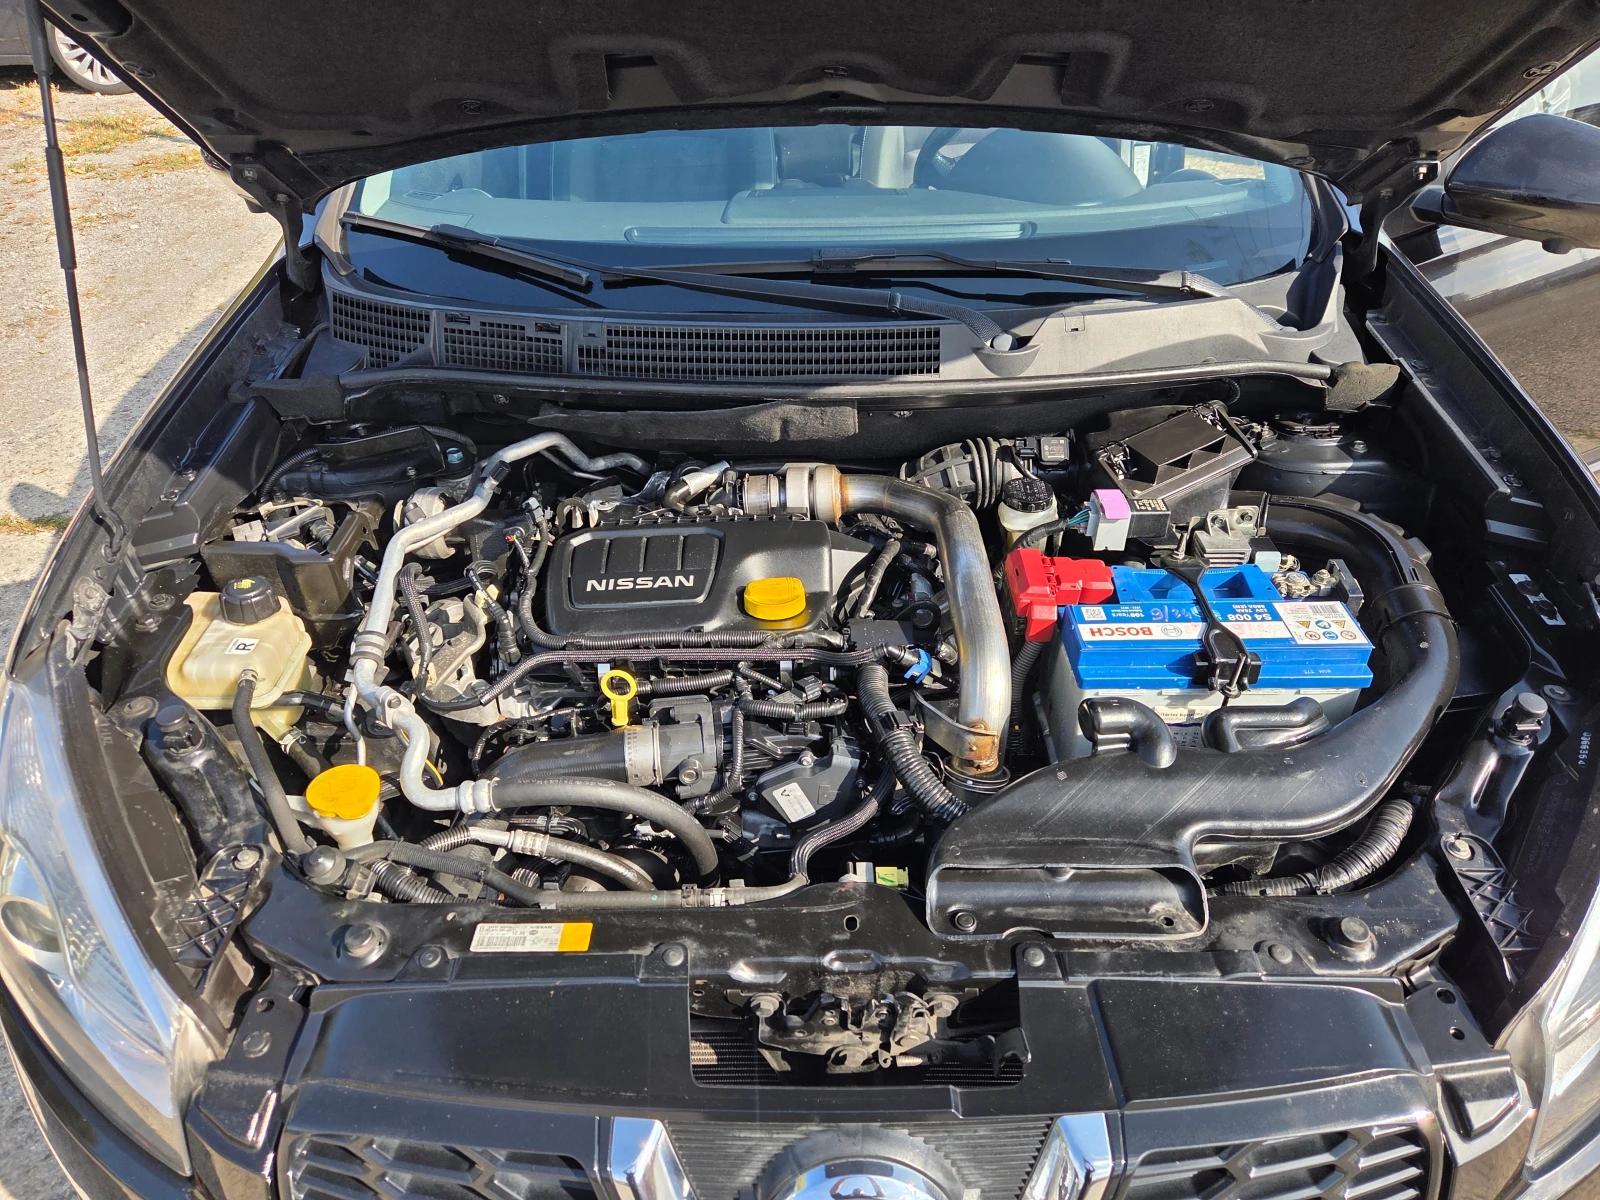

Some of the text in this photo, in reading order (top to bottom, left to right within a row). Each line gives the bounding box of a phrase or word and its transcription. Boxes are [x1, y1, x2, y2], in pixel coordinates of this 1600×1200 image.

[586, 575, 694, 591] NISSAN
[1227, 613, 1272, 621] S4 008
[1089, 626, 1154, 637] BOSCH
[235, 643, 255, 651] R
